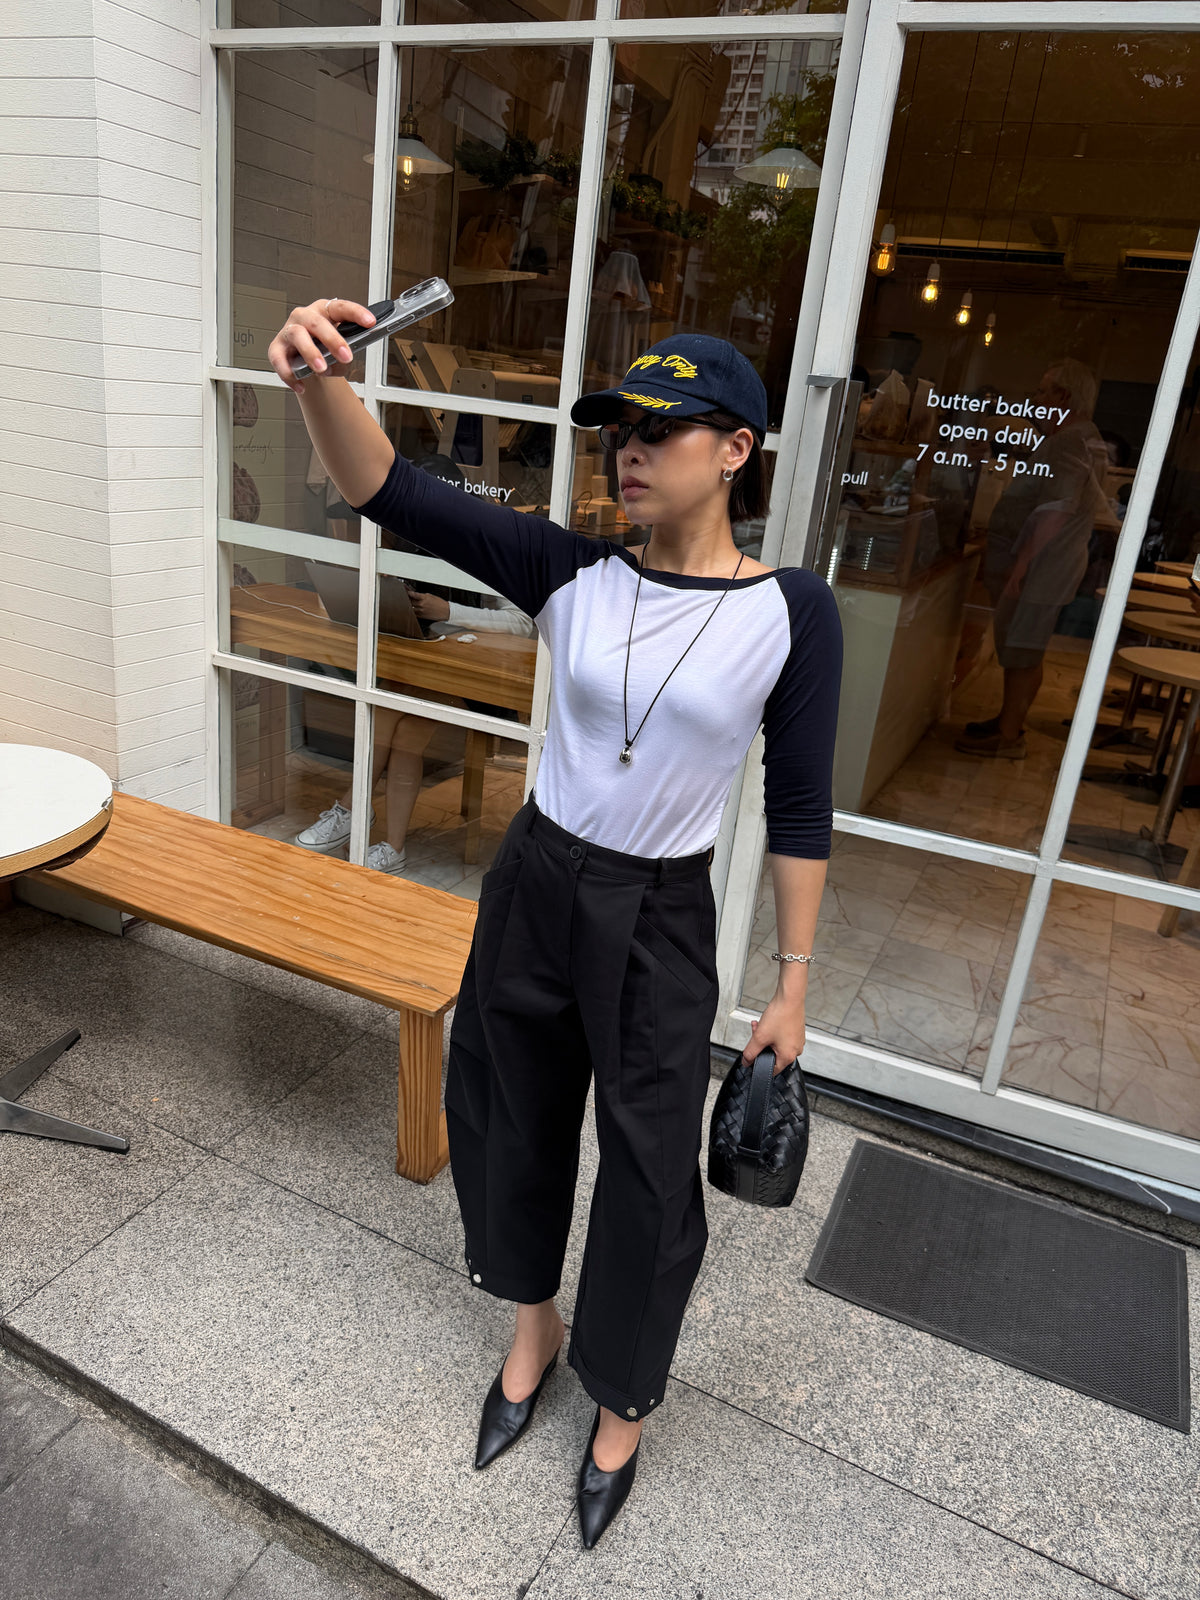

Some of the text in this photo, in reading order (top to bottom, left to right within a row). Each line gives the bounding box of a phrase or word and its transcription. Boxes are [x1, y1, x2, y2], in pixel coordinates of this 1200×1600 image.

[926, 388, 1071, 426] butter bakery
[938, 422, 1046, 452] open daily
[915, 443, 930, 462] 7
[933, 450, 973, 468] a.m.
[994, 453, 1008, 472] 5
[1012, 460, 1055, 478] p.m.
[464, 477, 512, 503] bakery
[840, 470, 868, 486] pull
